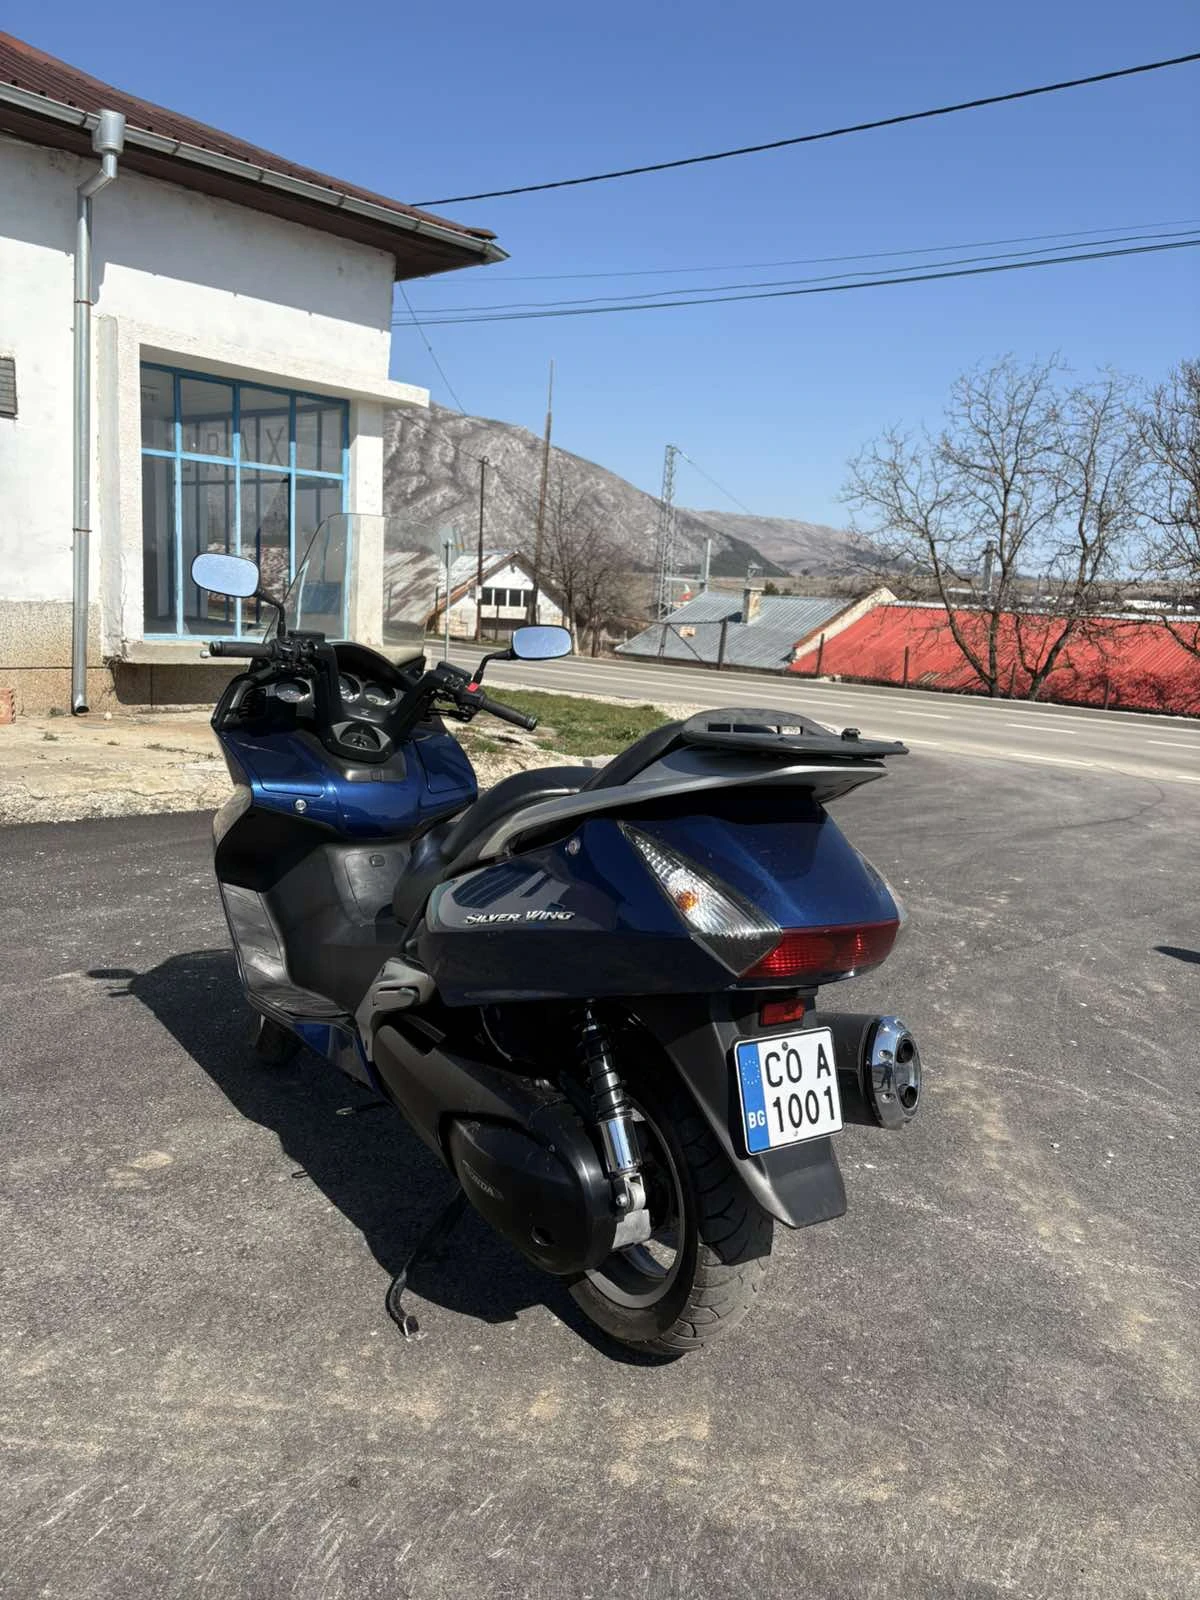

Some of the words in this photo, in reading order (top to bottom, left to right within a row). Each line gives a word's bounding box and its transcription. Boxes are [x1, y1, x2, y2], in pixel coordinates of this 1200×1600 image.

[465, 912, 522, 925] SILVER
[526, 910, 576, 921] WING
[765, 1048, 803, 1088] CO
[816, 1043, 832, 1079] A
[748, 1110, 766, 1129] BG
[773, 1085, 835, 1133] 1001
